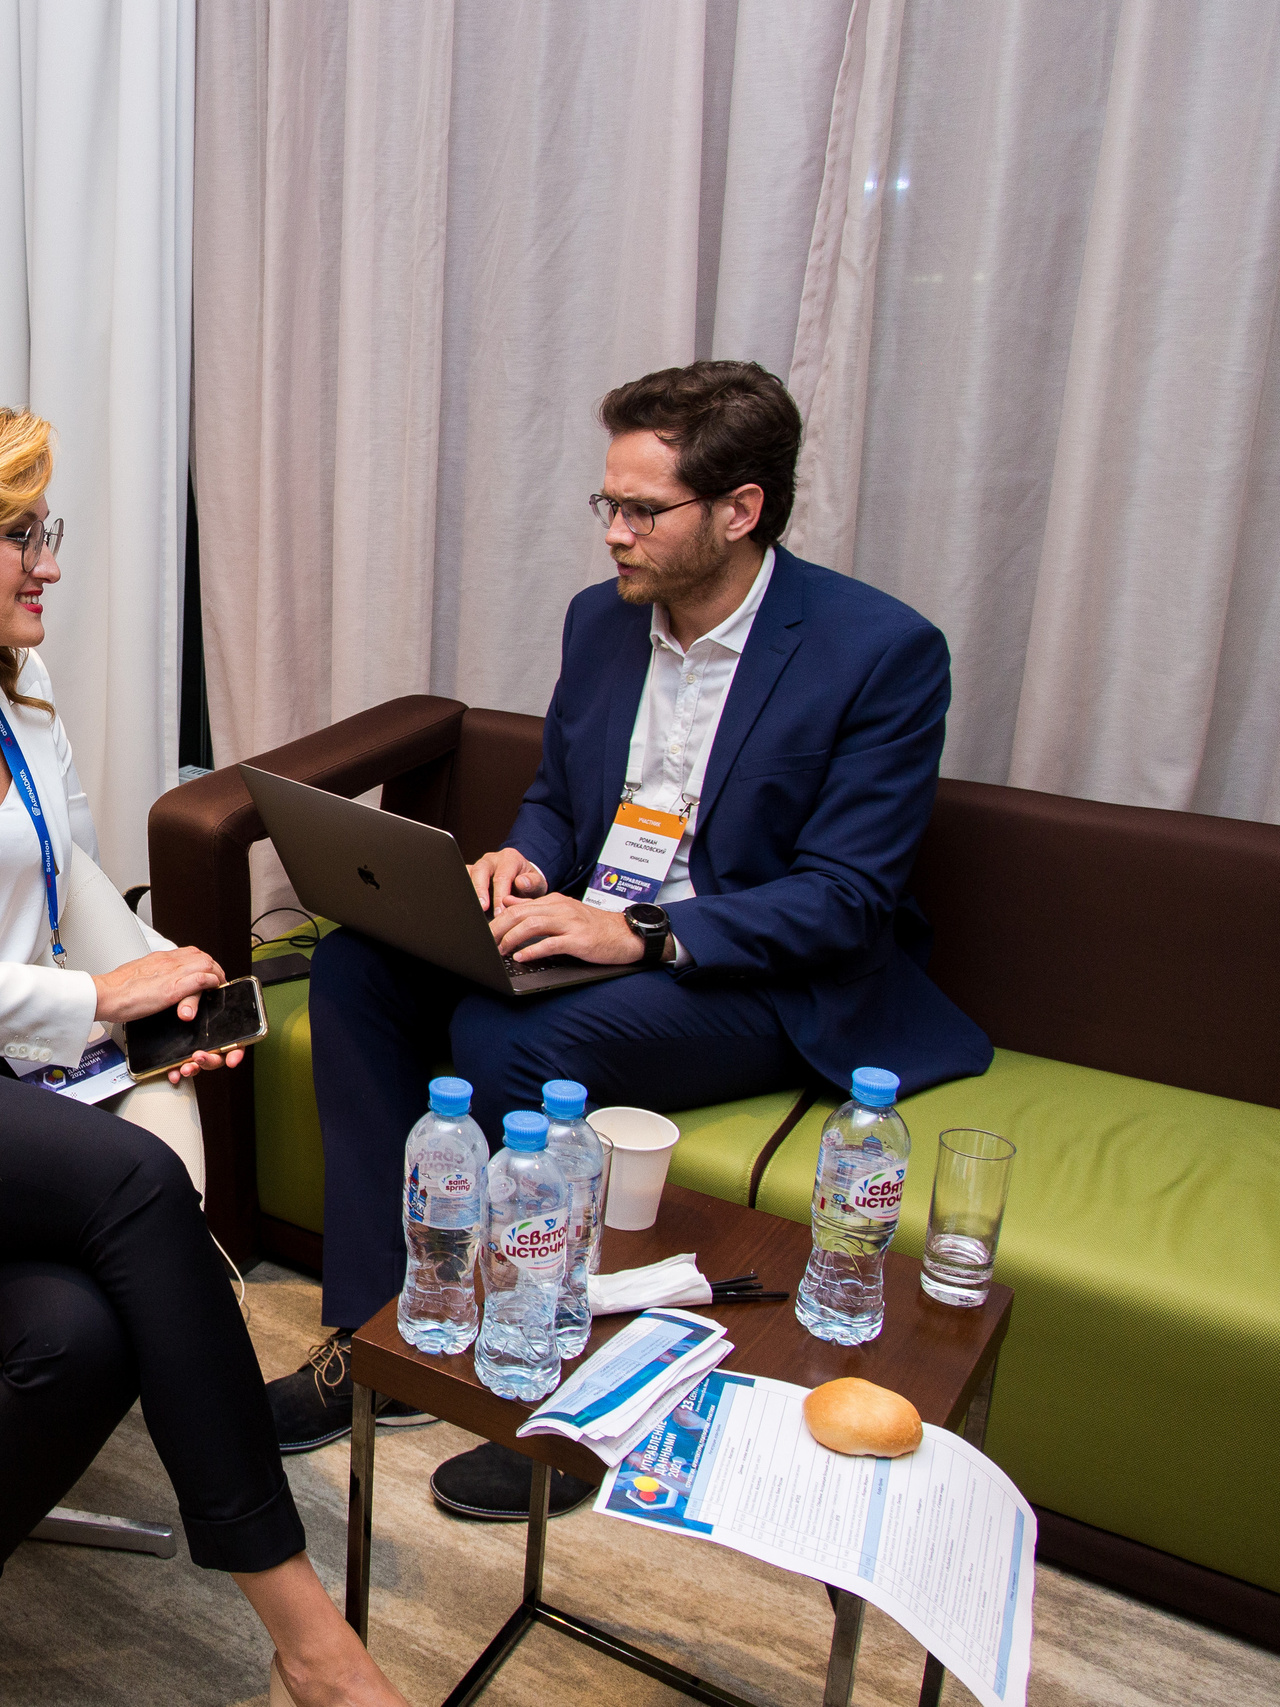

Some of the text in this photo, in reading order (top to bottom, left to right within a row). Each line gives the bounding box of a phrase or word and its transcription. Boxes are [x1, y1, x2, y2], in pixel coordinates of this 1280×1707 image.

[20, 769, 41, 808] ARENADATA
[638, 836, 658, 846] РОМАН
[44, 840, 52, 873] Solution
[617, 880, 643, 892] ДАННЫМИ
[619, 874, 651, 889] УПРАВЛЕНИЕ
[614, 885, 627, 894] 2021
[70, 1068, 86, 1079] 2021
[448, 1178, 469, 1186] saint
[445, 1184, 471, 1193] spring
[681, 1399, 695, 1411] 23
[640, 1420, 668, 1472] УПРАВЛЕНИЕ
[654, 1432, 678, 1476] ДАННЫМИ
[667, 1459, 683, 1478] 2021
